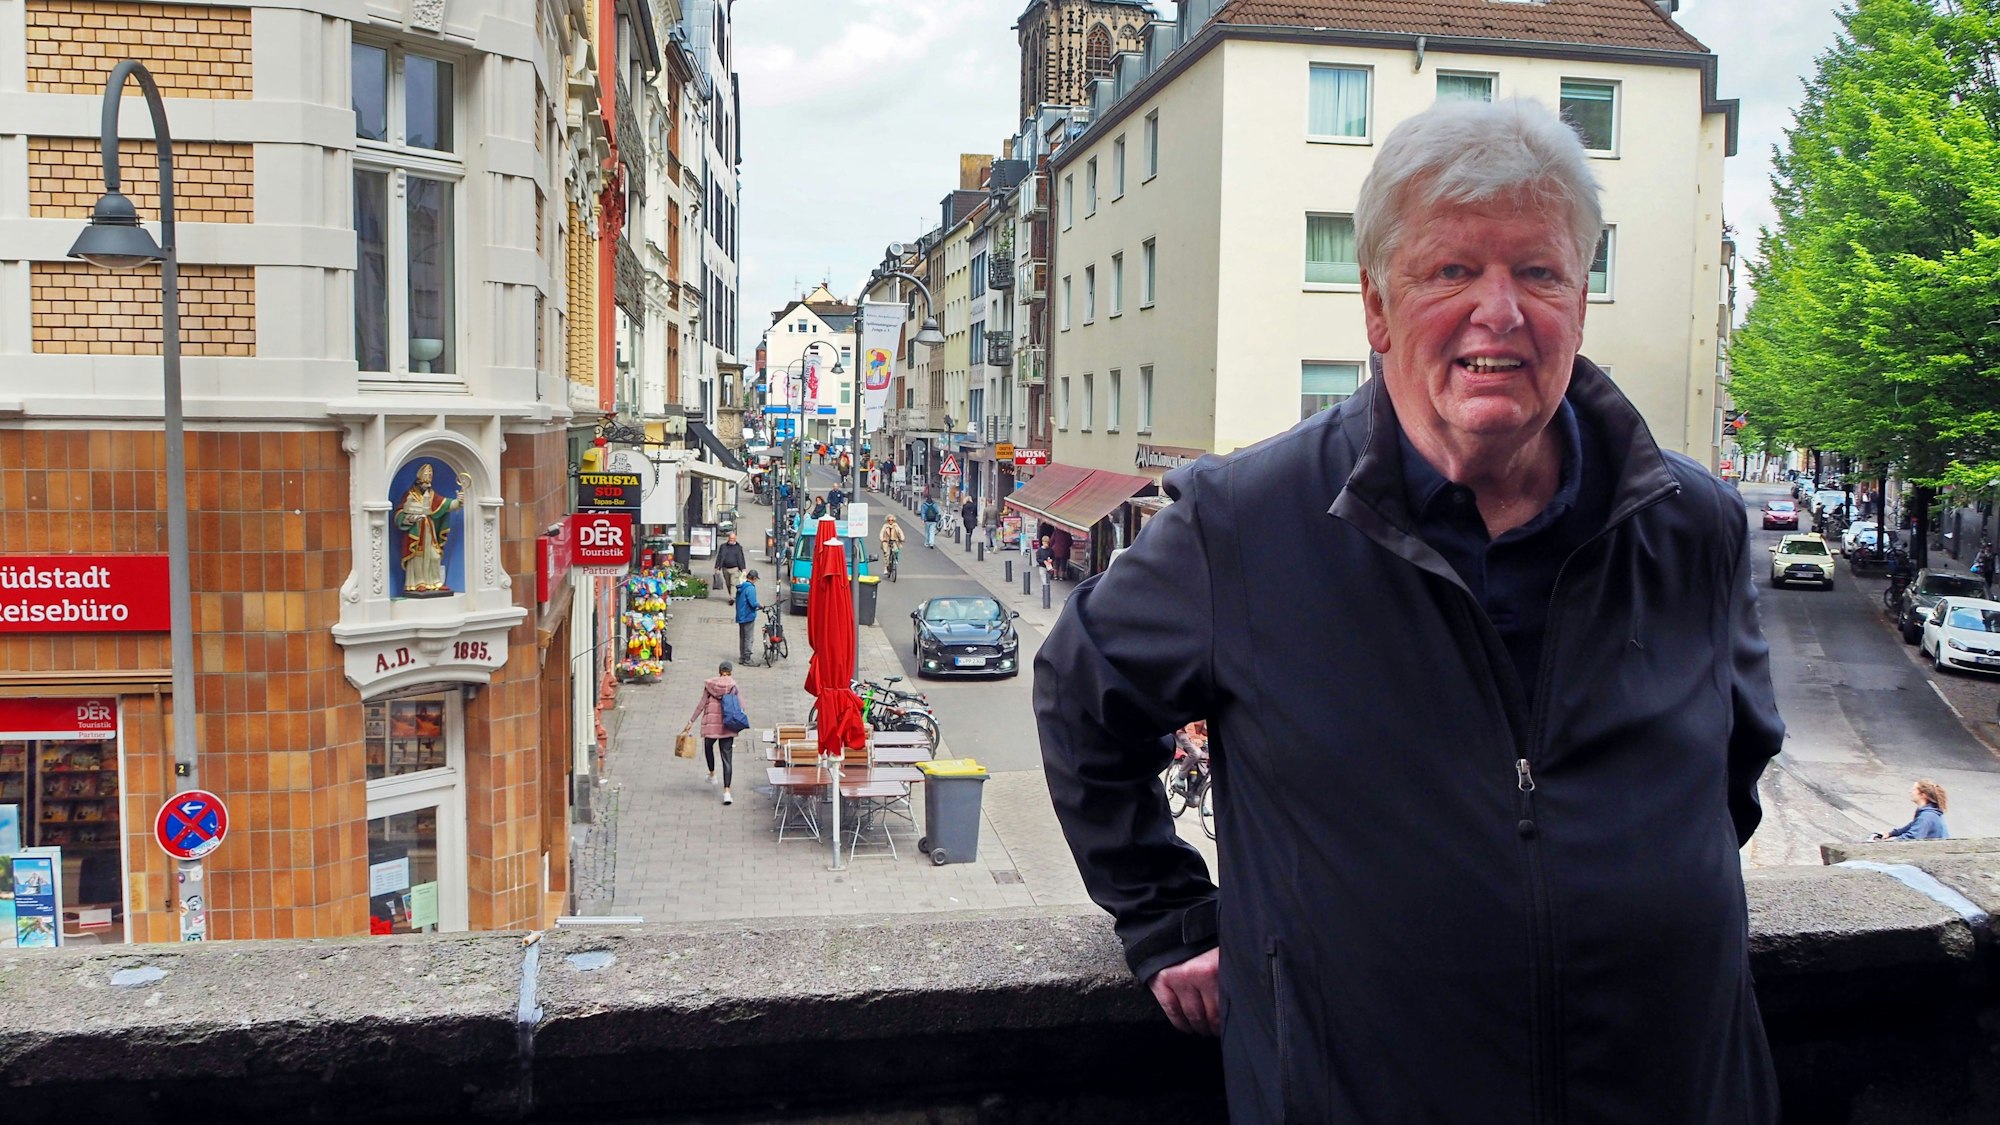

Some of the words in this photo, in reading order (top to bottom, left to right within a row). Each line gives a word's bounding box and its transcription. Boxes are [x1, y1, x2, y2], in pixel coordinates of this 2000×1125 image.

[1015, 450, 1046, 458] KIOSK
[580, 475, 639, 486] TURISTA
[595, 484, 623, 497] SÜD
[593, 498, 626, 506] Tapas-Bar
[580, 526, 624, 546] DER
[581, 547, 624, 557] Touristik
[583, 566, 618, 575] Partner
[0, 599, 129, 622] eisebüro
[376, 647, 416, 673] A.D.
[453, 641, 492, 661] 1895.
[77, 706, 112, 721] DER
[78, 721, 112, 729] Touristik
[178, 765, 185, 774] 2
